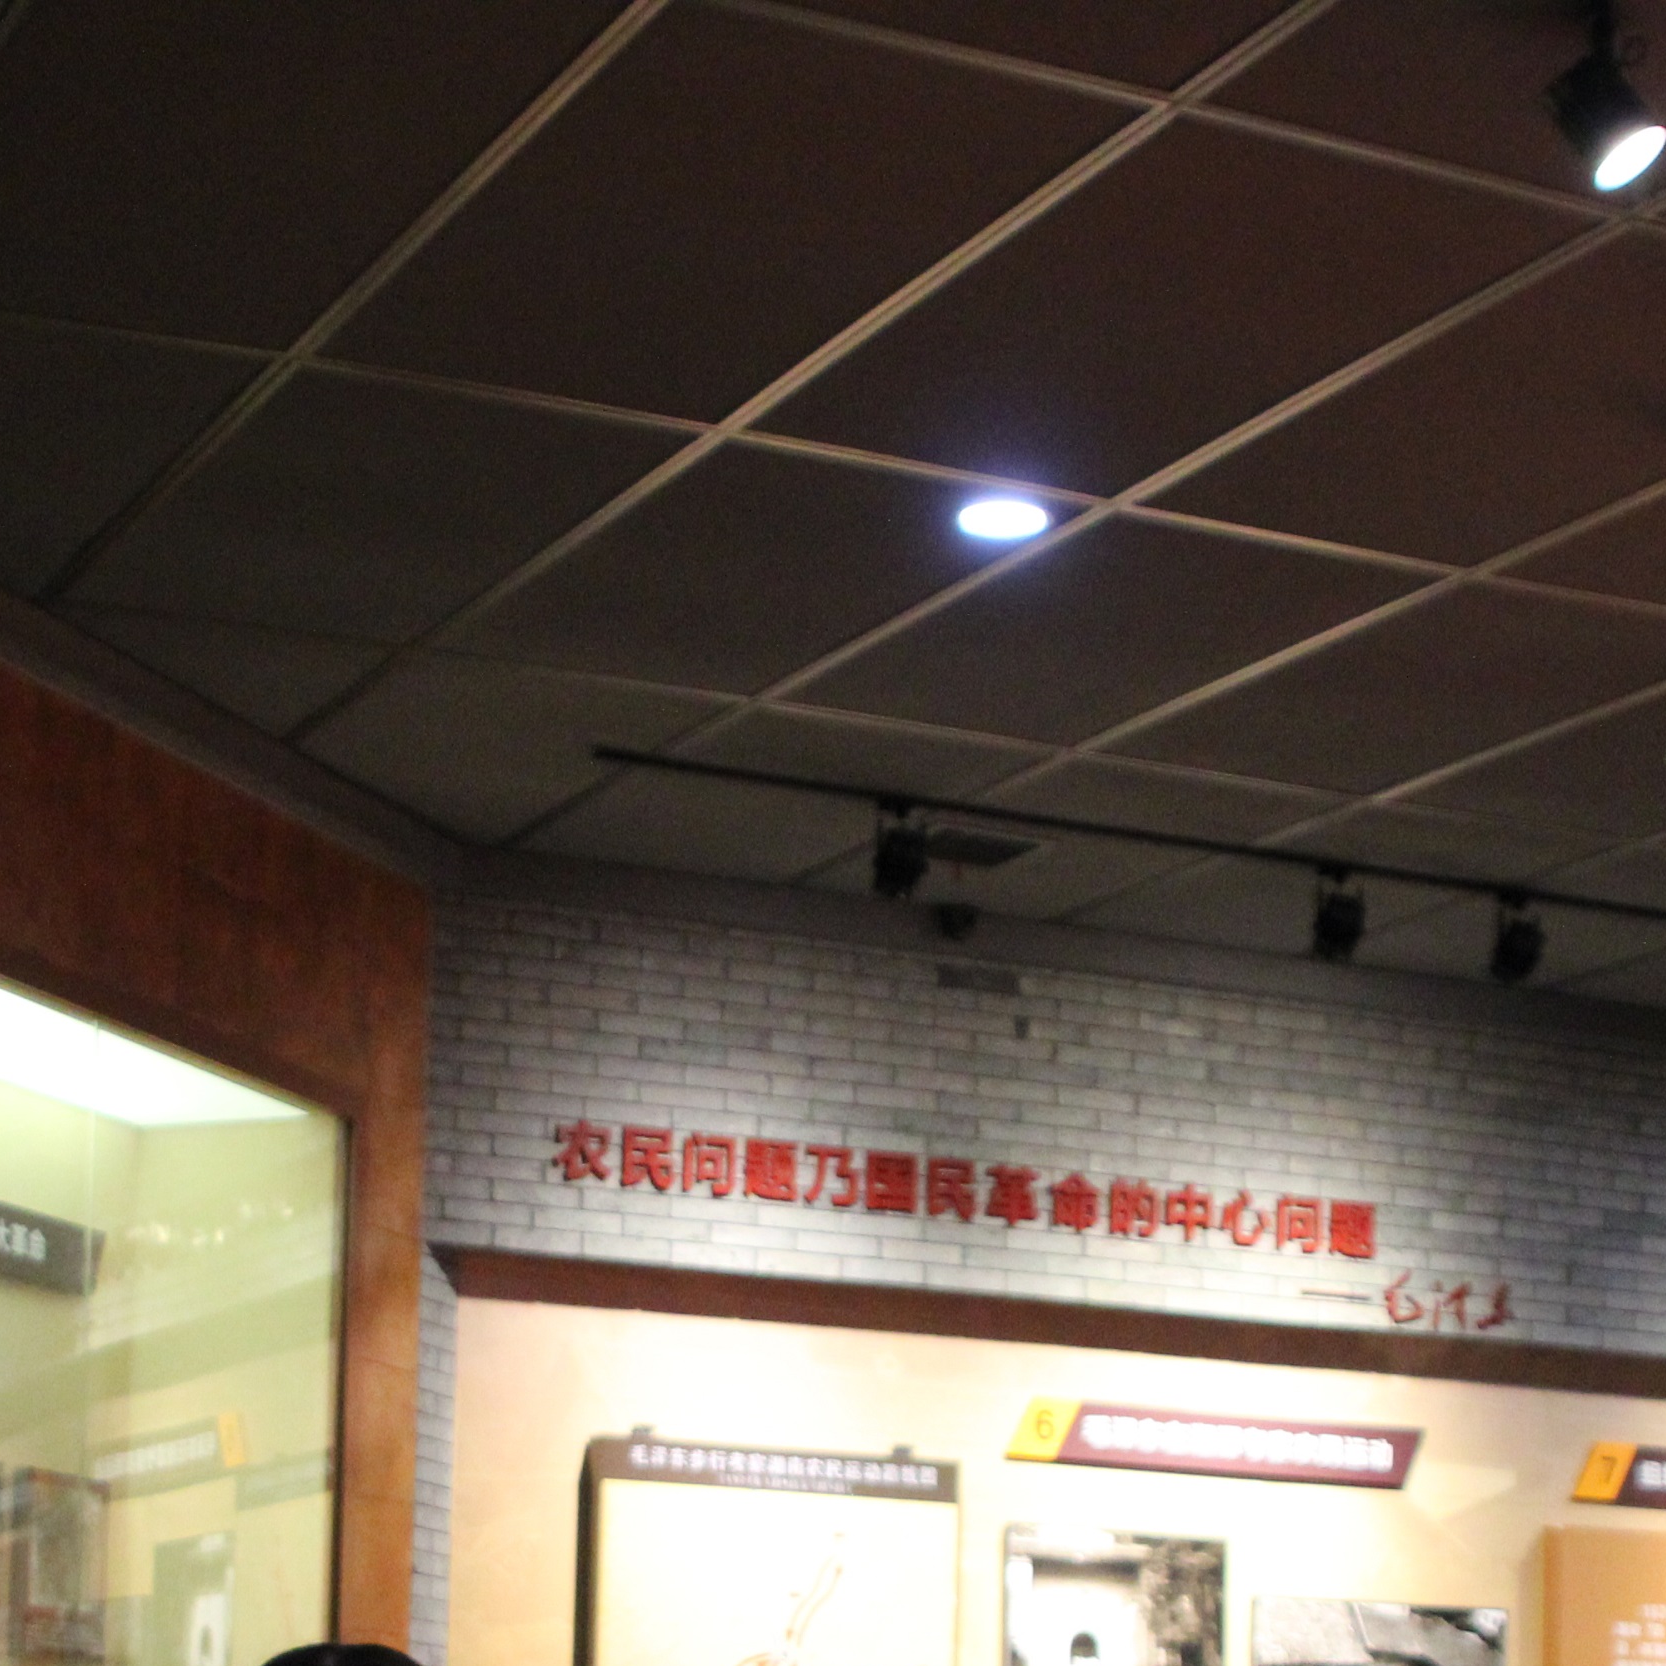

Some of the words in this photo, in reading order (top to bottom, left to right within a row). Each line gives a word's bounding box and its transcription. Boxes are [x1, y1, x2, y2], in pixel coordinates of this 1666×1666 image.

[549, 1117, 1379, 1261] 农民问题乃国民革命的中心问题
[1033, 1408, 1055, 1440] 6
